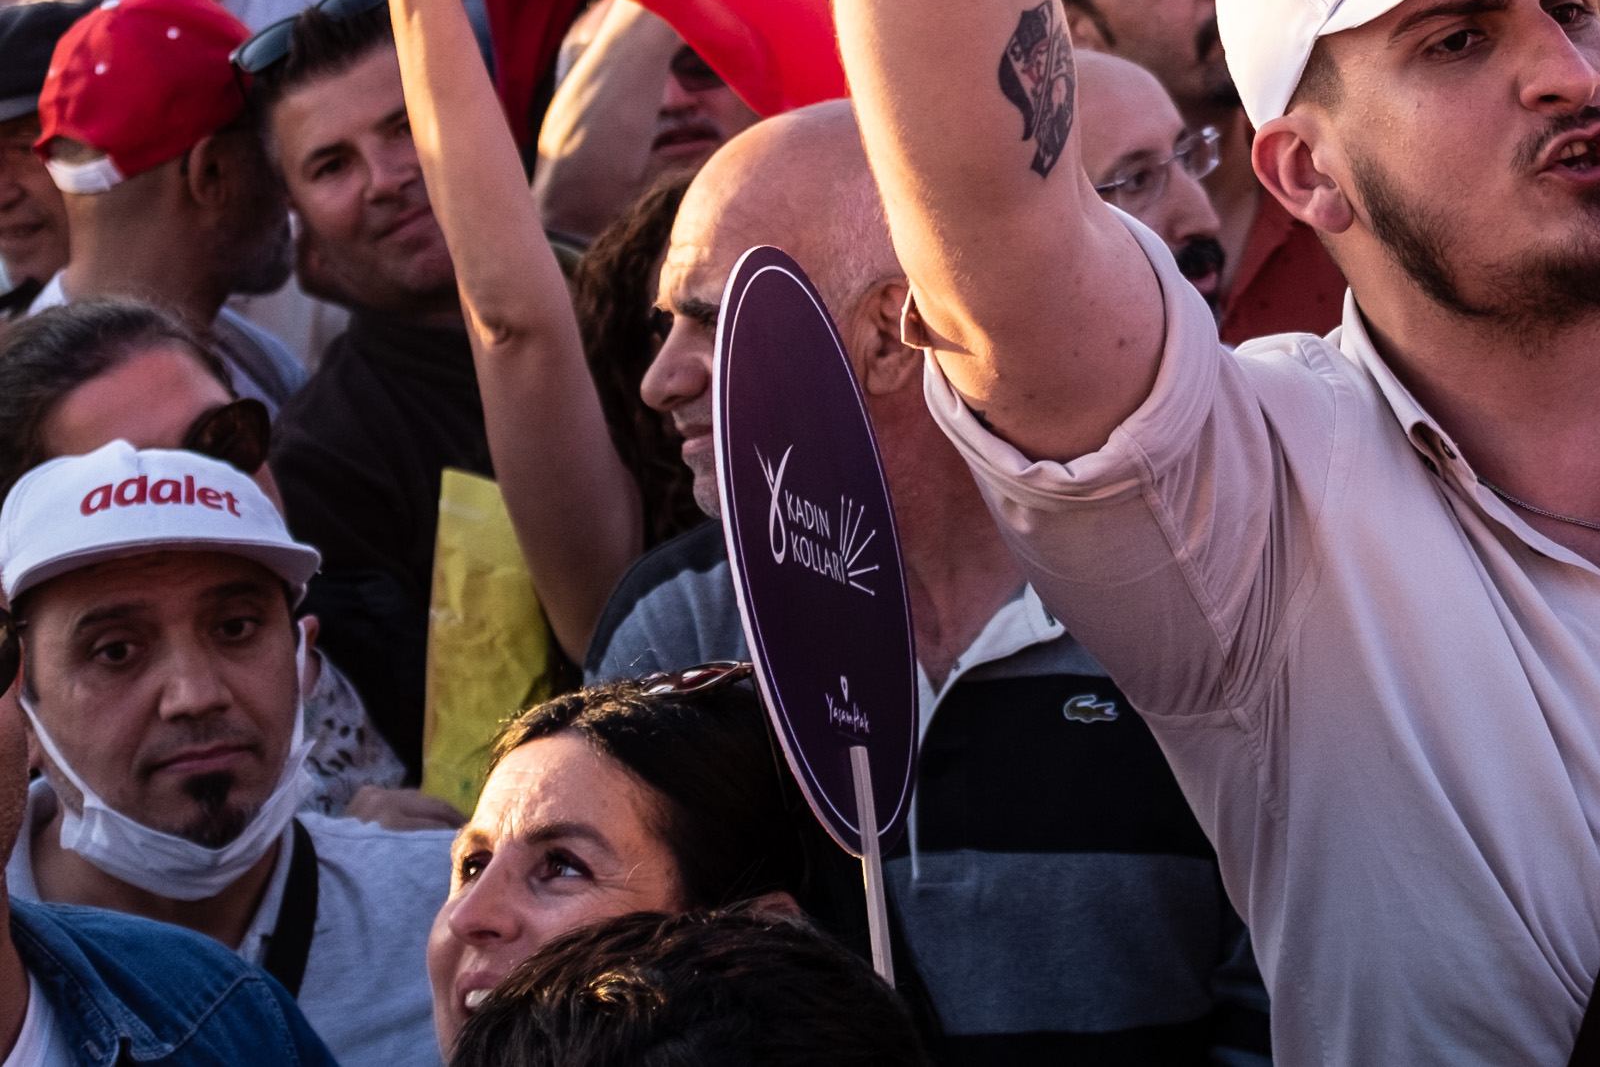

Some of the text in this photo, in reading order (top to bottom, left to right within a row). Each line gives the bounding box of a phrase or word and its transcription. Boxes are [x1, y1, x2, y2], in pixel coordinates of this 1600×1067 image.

[80, 475, 241, 518] adalet
[785, 490, 830, 539] KADIN
[791, 531, 846, 585] KOLLARI
